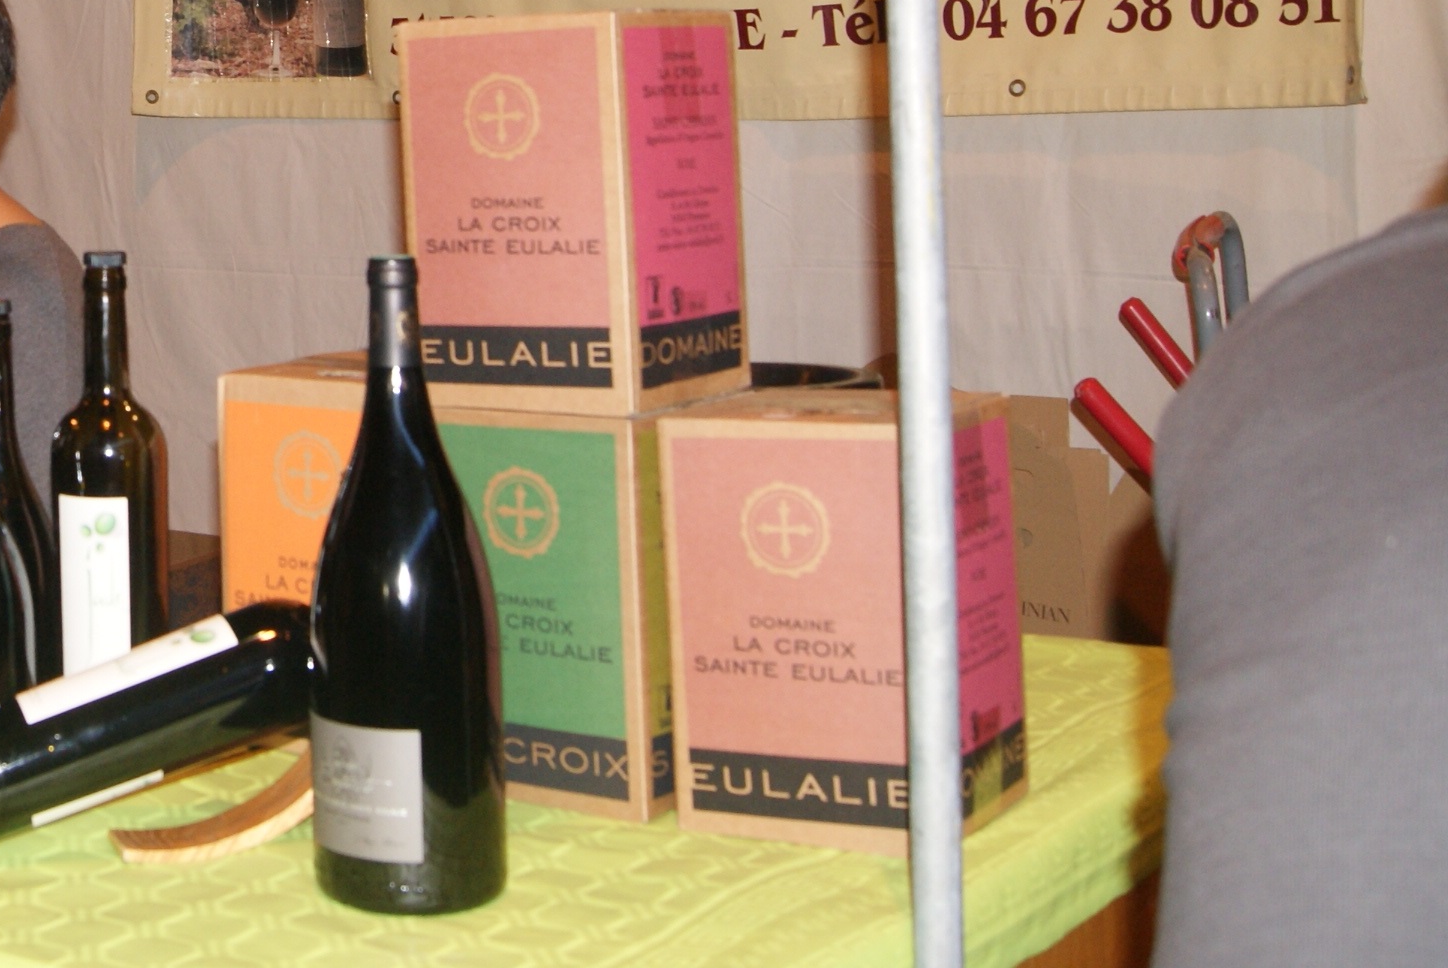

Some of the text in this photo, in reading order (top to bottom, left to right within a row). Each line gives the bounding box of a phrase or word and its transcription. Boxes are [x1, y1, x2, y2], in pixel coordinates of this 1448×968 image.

[471, 197, 544, 210] DOMAINE
[457, 217, 562, 232] LA CROIX
[426, 238, 601, 255] SAINTE EULALIE
[420, 339, 612, 368] EULALIE
[640, 324, 742, 369] DOMAINE
[265, 574, 289, 591] LA
[495, 592, 557, 611] OMAINE
[1021, 601, 1070, 623] INIAN
[504, 612, 573, 636] CROIX
[749, 615, 836, 633] DOMAINE
[519, 638, 613, 664] EULALIE
[732, 635, 856, 659] LA CROIX
[694, 655, 904, 688] SAINTE EULALIE
[503, 737, 629, 781] CROIX
[690, 763, 909, 809] EULALIE
